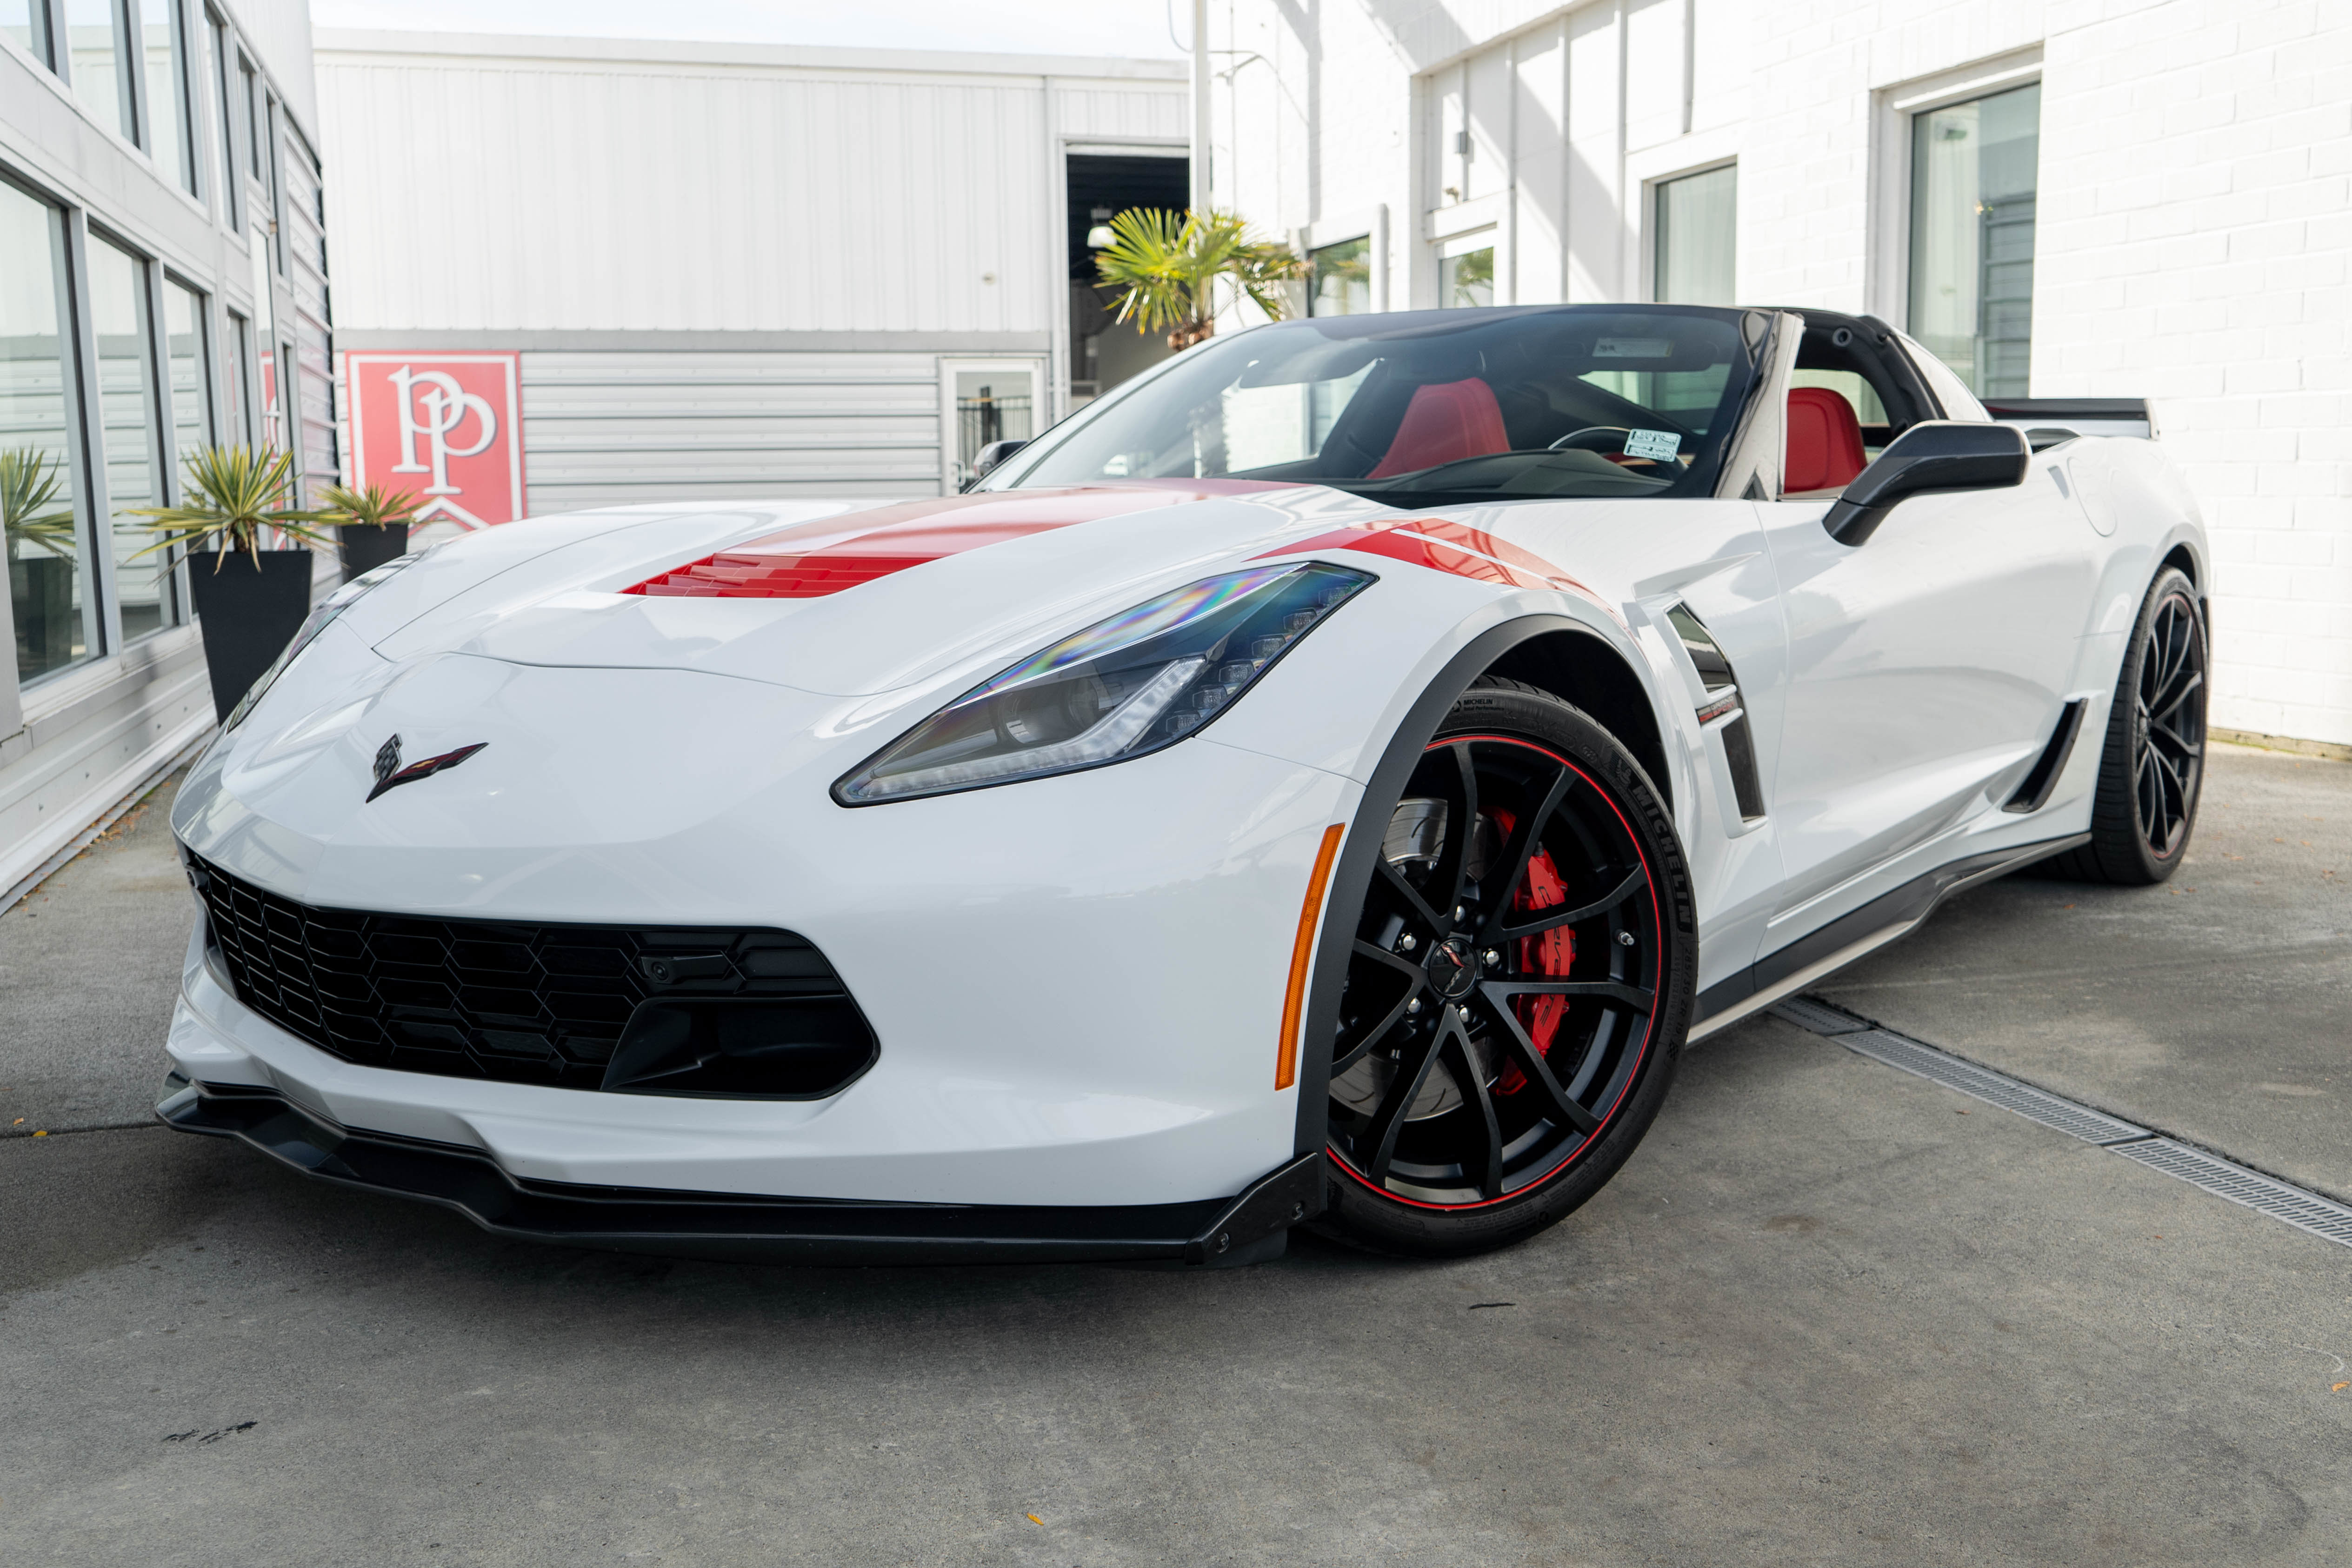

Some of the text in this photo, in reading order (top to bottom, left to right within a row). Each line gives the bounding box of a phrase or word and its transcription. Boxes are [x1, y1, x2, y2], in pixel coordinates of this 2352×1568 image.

[1711, 696, 1733, 711] GRAND
[1713, 701, 1734, 716] SPORT
[1633, 784, 1692, 923] MICHELIN
[1683, 947, 1692, 995] 285/30
[1679, 999, 1687, 1017] ZR
